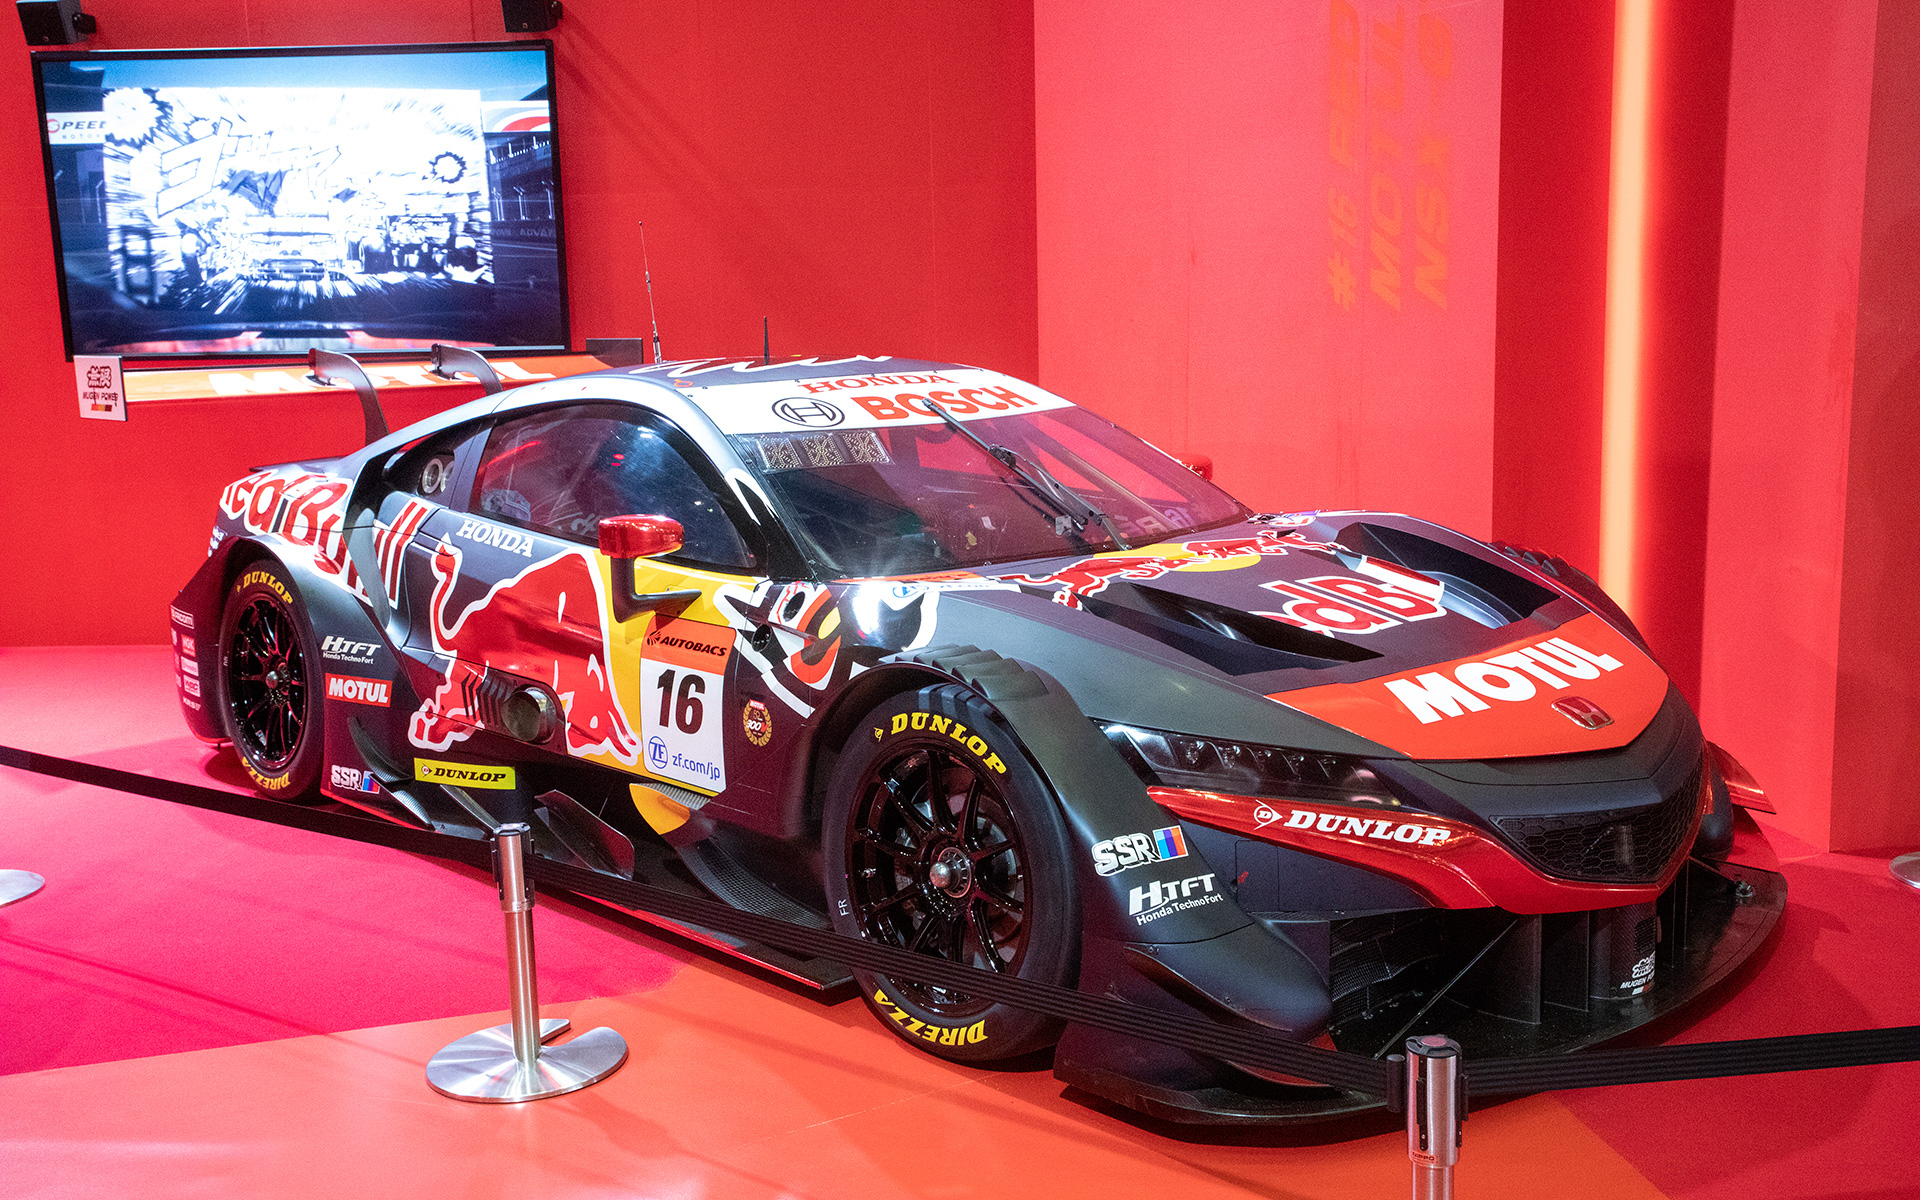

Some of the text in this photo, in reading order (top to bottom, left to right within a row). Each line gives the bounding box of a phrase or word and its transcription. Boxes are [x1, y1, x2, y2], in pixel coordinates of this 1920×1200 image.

[797, 374, 960, 394] HONDA
[850, 385, 1039, 421] BOSCH
[455, 519, 534, 557] HONDA
[243, 571, 293, 604] DUNLOP
[323, 651, 341, 660] Honda
[660, 636, 728, 657] AUTOBACS
[328, 677, 389, 703] MOTUL
[1383, 636, 1624, 725] MOTUL
[657, 669, 706, 735] 16
[746, 719, 770, 732] 300V
[891, 712, 1008, 776] DUNLOP
[241, 756, 291, 790] DIREZZA
[331, 764, 362, 790] SSR
[434, 767, 507, 782] DUNLOP
[671, 753, 721, 781] zf.com/jp
[1283, 809, 1452, 846] DUNLOP
[1091, 832, 1161, 877] SSR
[837, 898, 850, 917] FR
[1136, 907, 1174, 926] Honda
[1620, 976, 1648, 989] MUGEN
[873, 988, 989, 1047] DIREZZA
